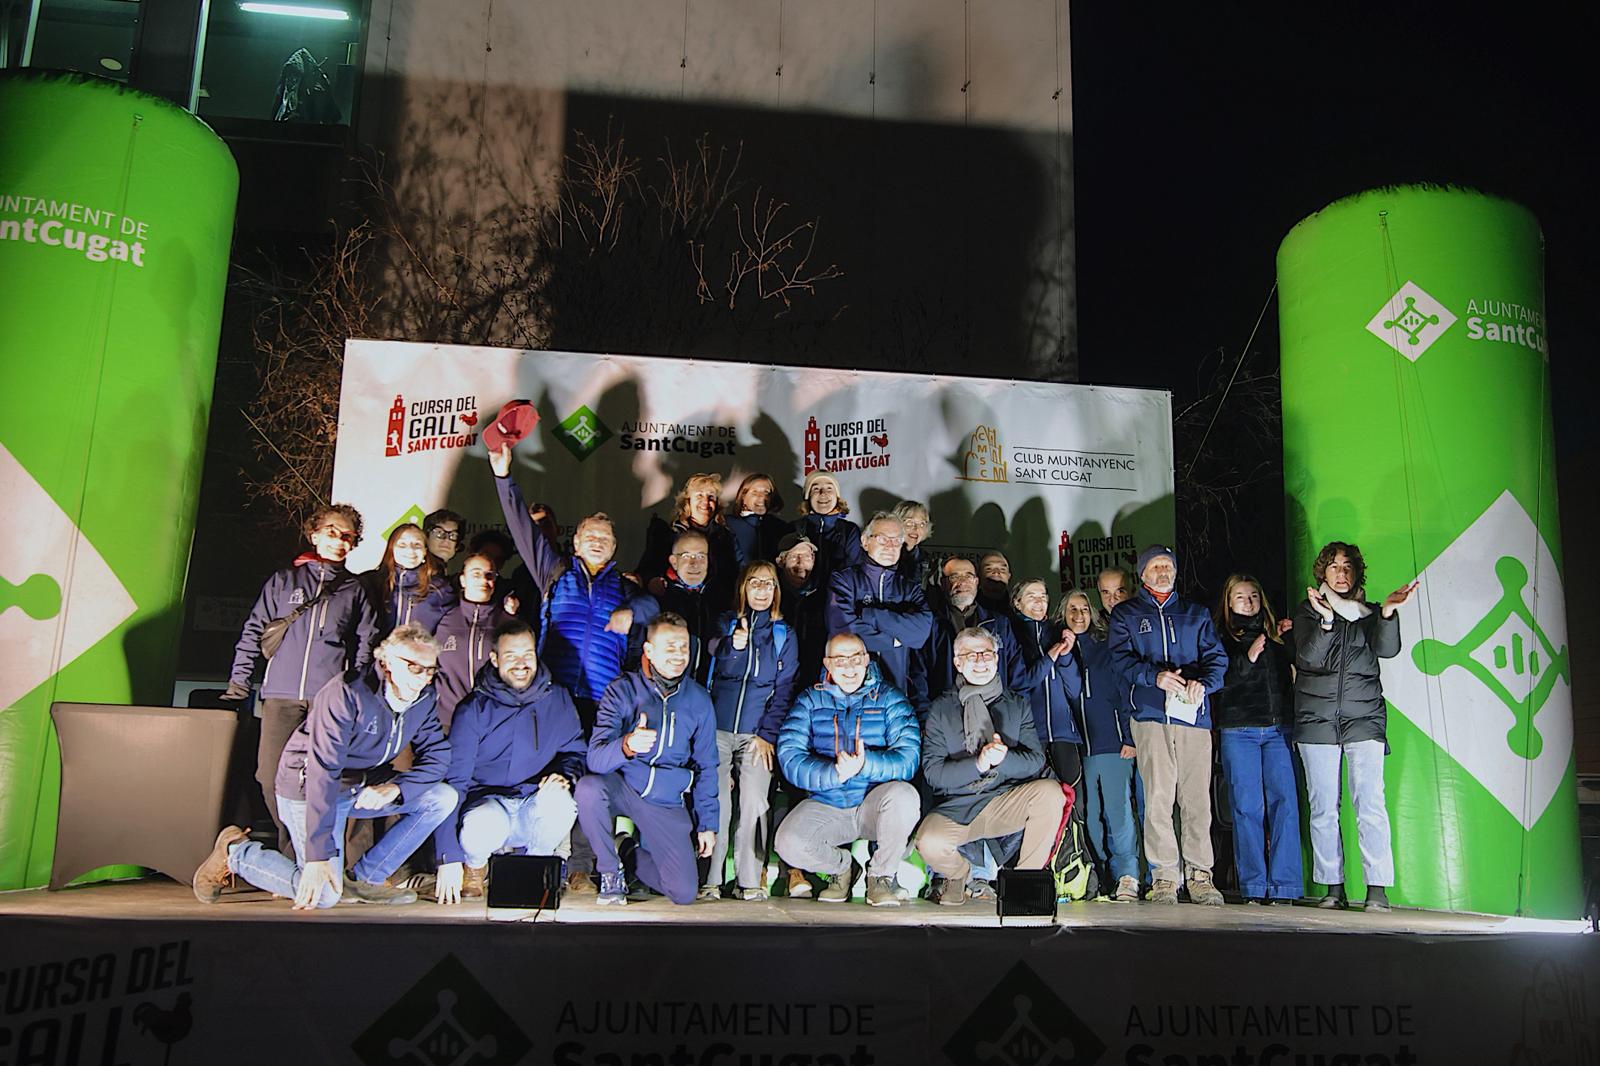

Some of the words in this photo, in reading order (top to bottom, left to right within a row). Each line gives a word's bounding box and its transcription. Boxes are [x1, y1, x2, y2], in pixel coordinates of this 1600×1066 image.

[0, 194, 116, 229] NTAMENT
[120, 216, 149, 240] DE
[411, 399, 452, 416] CURSA
[457, 396, 477, 412] DEL
[409, 415, 459, 439] GALL
[622, 421, 714, 437] AJUNTAMENT
[718, 426, 736, 438] DE
[825, 421, 863, 438] CURSA
[867, 418, 887, 434] DEL
[407, 437, 438, 454] SANT
[440, 433, 478, 449] CUGAT
[620, 434, 736, 458] SantCugat
[825, 436, 872, 459] GALL
[824, 458, 853, 472] SANT
[855, 454, 891, 470] CUGAT
[1013, 452, 1044, 465] CLUB
[1047, 456, 1136, 471] MUNTANYENC
[1015, 467, 1047, 480] SANT
[1050, 469, 1093, 483] CUGAT
[1078, 537, 1114, 553] CURSA
[1117, 534, 1137, 549] DEL
[126, 940, 194, 995] DEL
[555, 1000, 817, 1035] AJUNTAMENT
[829, 1003, 876, 1036] DE
[1124, 1004, 1360, 1037] AJUNTAMENT
[1371, 1005, 1416, 1036] DE
